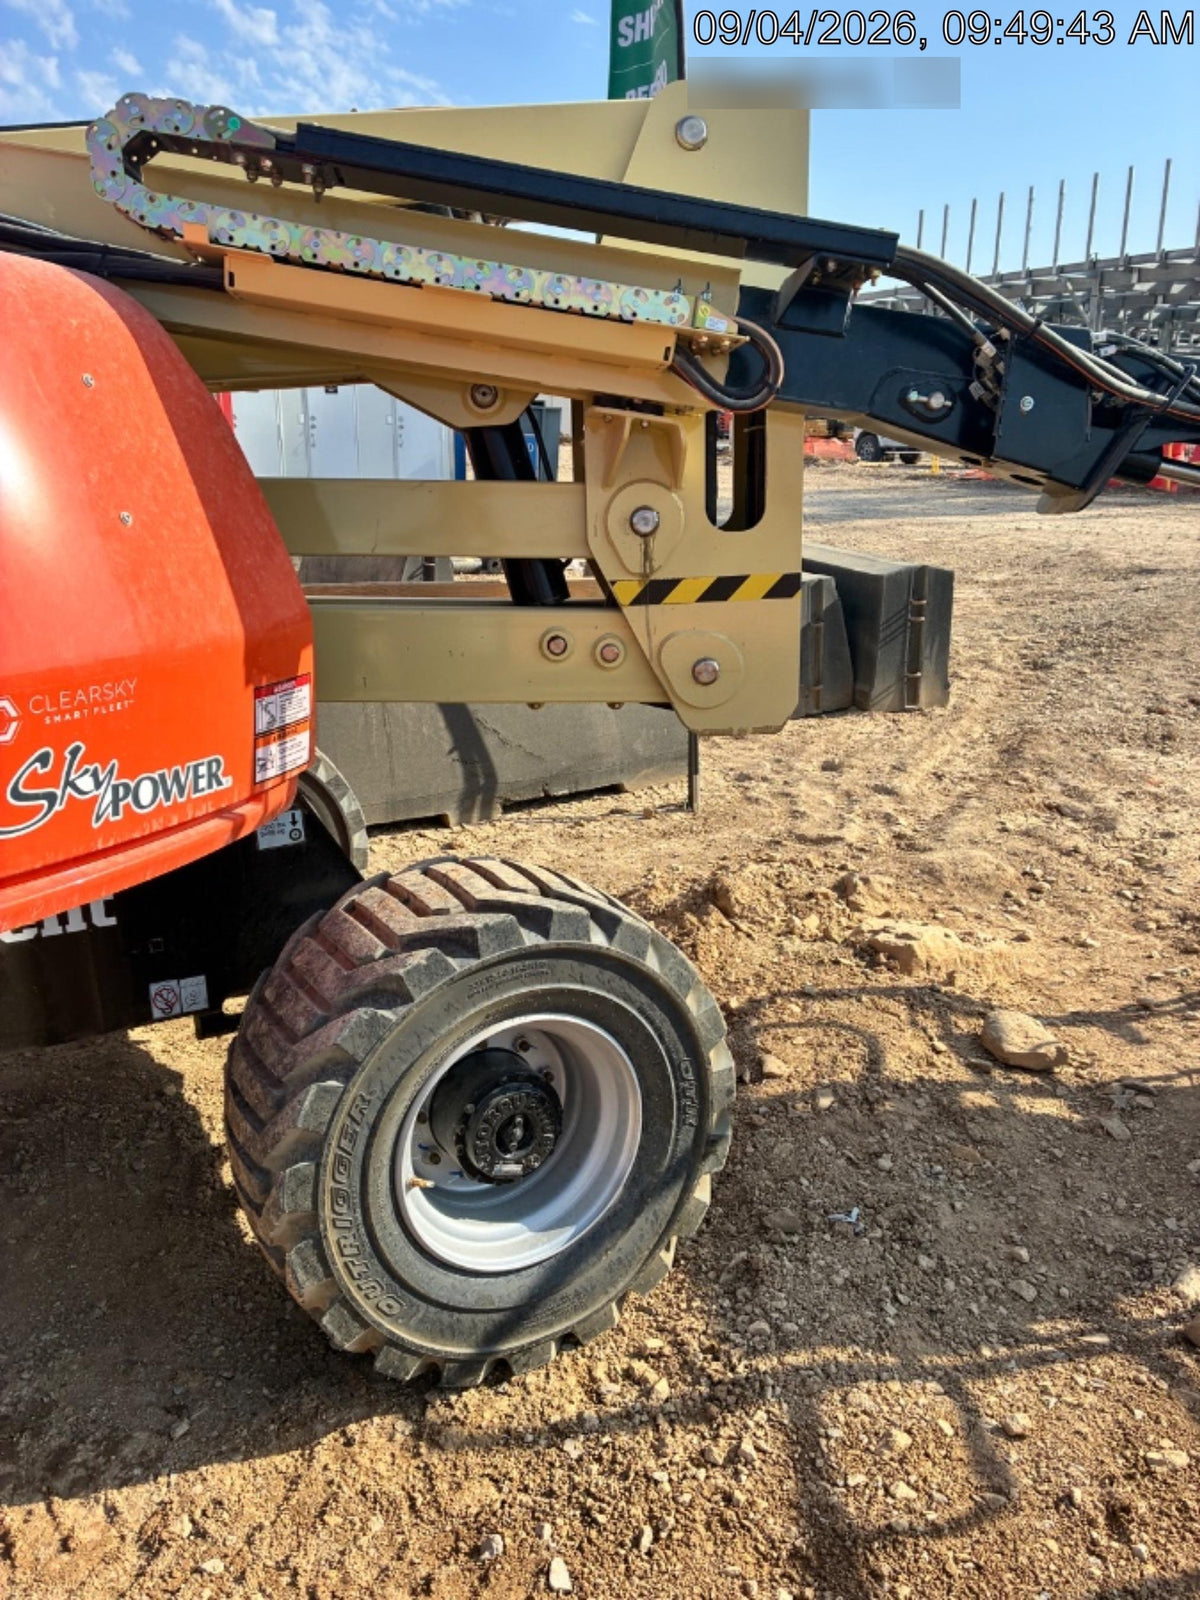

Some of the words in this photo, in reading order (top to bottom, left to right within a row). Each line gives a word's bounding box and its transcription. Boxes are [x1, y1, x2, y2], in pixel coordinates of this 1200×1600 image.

[29, 678, 137, 714] CLEARSKY
[45, 710, 89, 725] SMART
[331, 1092, 405, 1317] OUTRIGGER
